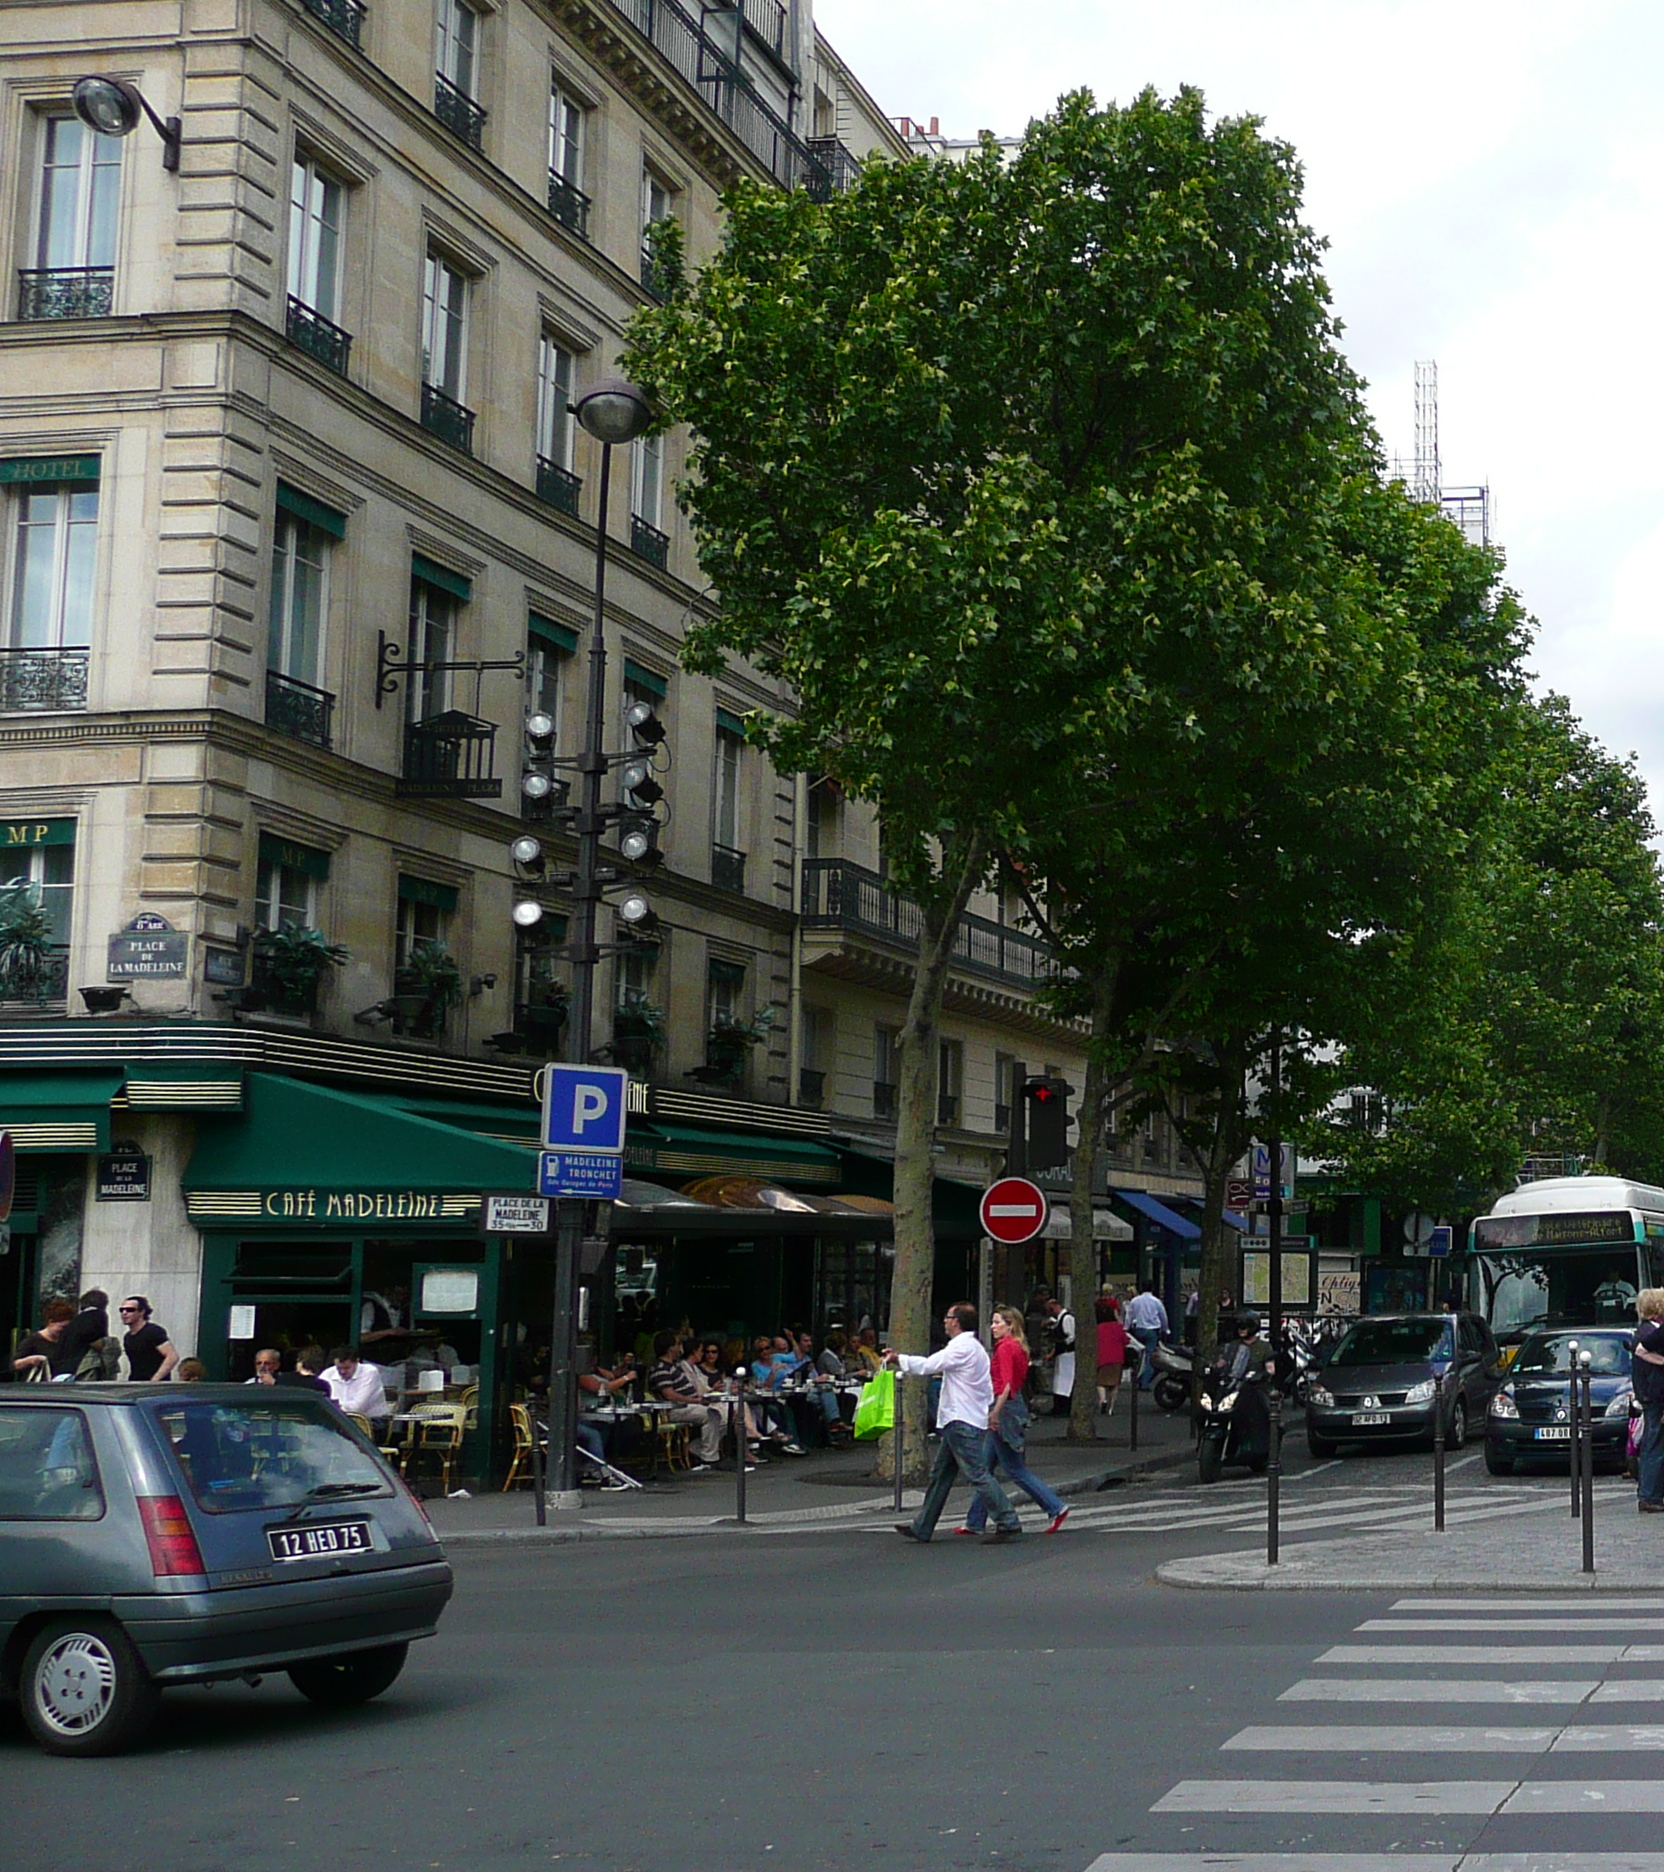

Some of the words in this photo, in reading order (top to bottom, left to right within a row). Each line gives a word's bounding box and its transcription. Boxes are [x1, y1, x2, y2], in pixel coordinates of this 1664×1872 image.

[13, 461, 85, 478] HOTEL
[130, 941, 167, 952] PLACE
[141, 952, 154, 961] DE
[110, 963, 123, 973] LA
[124, 962, 184, 973] MADELEINE
[572, 1083, 609, 1135] P
[112, 1162, 138, 1173] PLACE
[565, 1155, 618, 1168] MADELEINE
[569, 1168, 617, 1181] TRONCHET
[101, 1183, 147, 1194] MADELEINE
[266, 1189, 316, 1217] CAFÉ
[493, 1198, 519, 1208] PLACE
[521, 1199, 532, 1208] DE
[534, 1200, 544, 1209] LA
[495, 1208, 541, 1221] MADELEINE
[491, 1219, 506, 1230] 35
[530, 1220, 544, 1230] 30
[280, 1533, 304, 1556] 12
[305, 1528, 338, 1552] HED
[340, 1525, 362, 1548] 75
